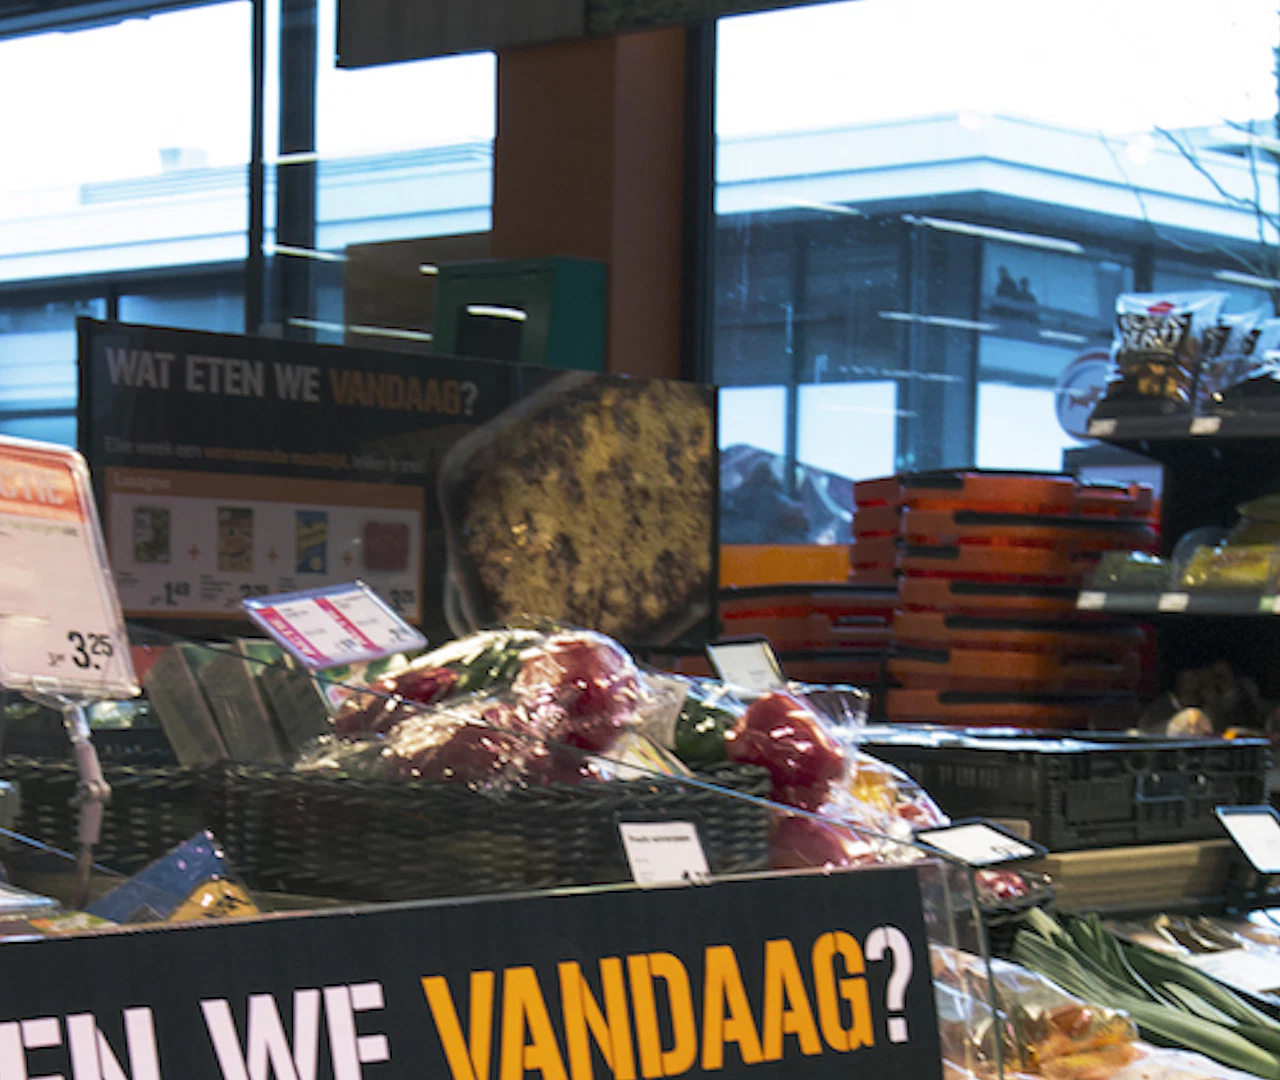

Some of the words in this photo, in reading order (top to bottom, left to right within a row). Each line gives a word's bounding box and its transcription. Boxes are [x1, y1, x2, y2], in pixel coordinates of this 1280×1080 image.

[103, 346, 177, 391] WAT
[184, 355, 266, 399] ETEN
[273, 360, 322, 404] WE
[327, 368, 480, 418] VANDAAG?
[67, 631, 113, 670] 3.25
